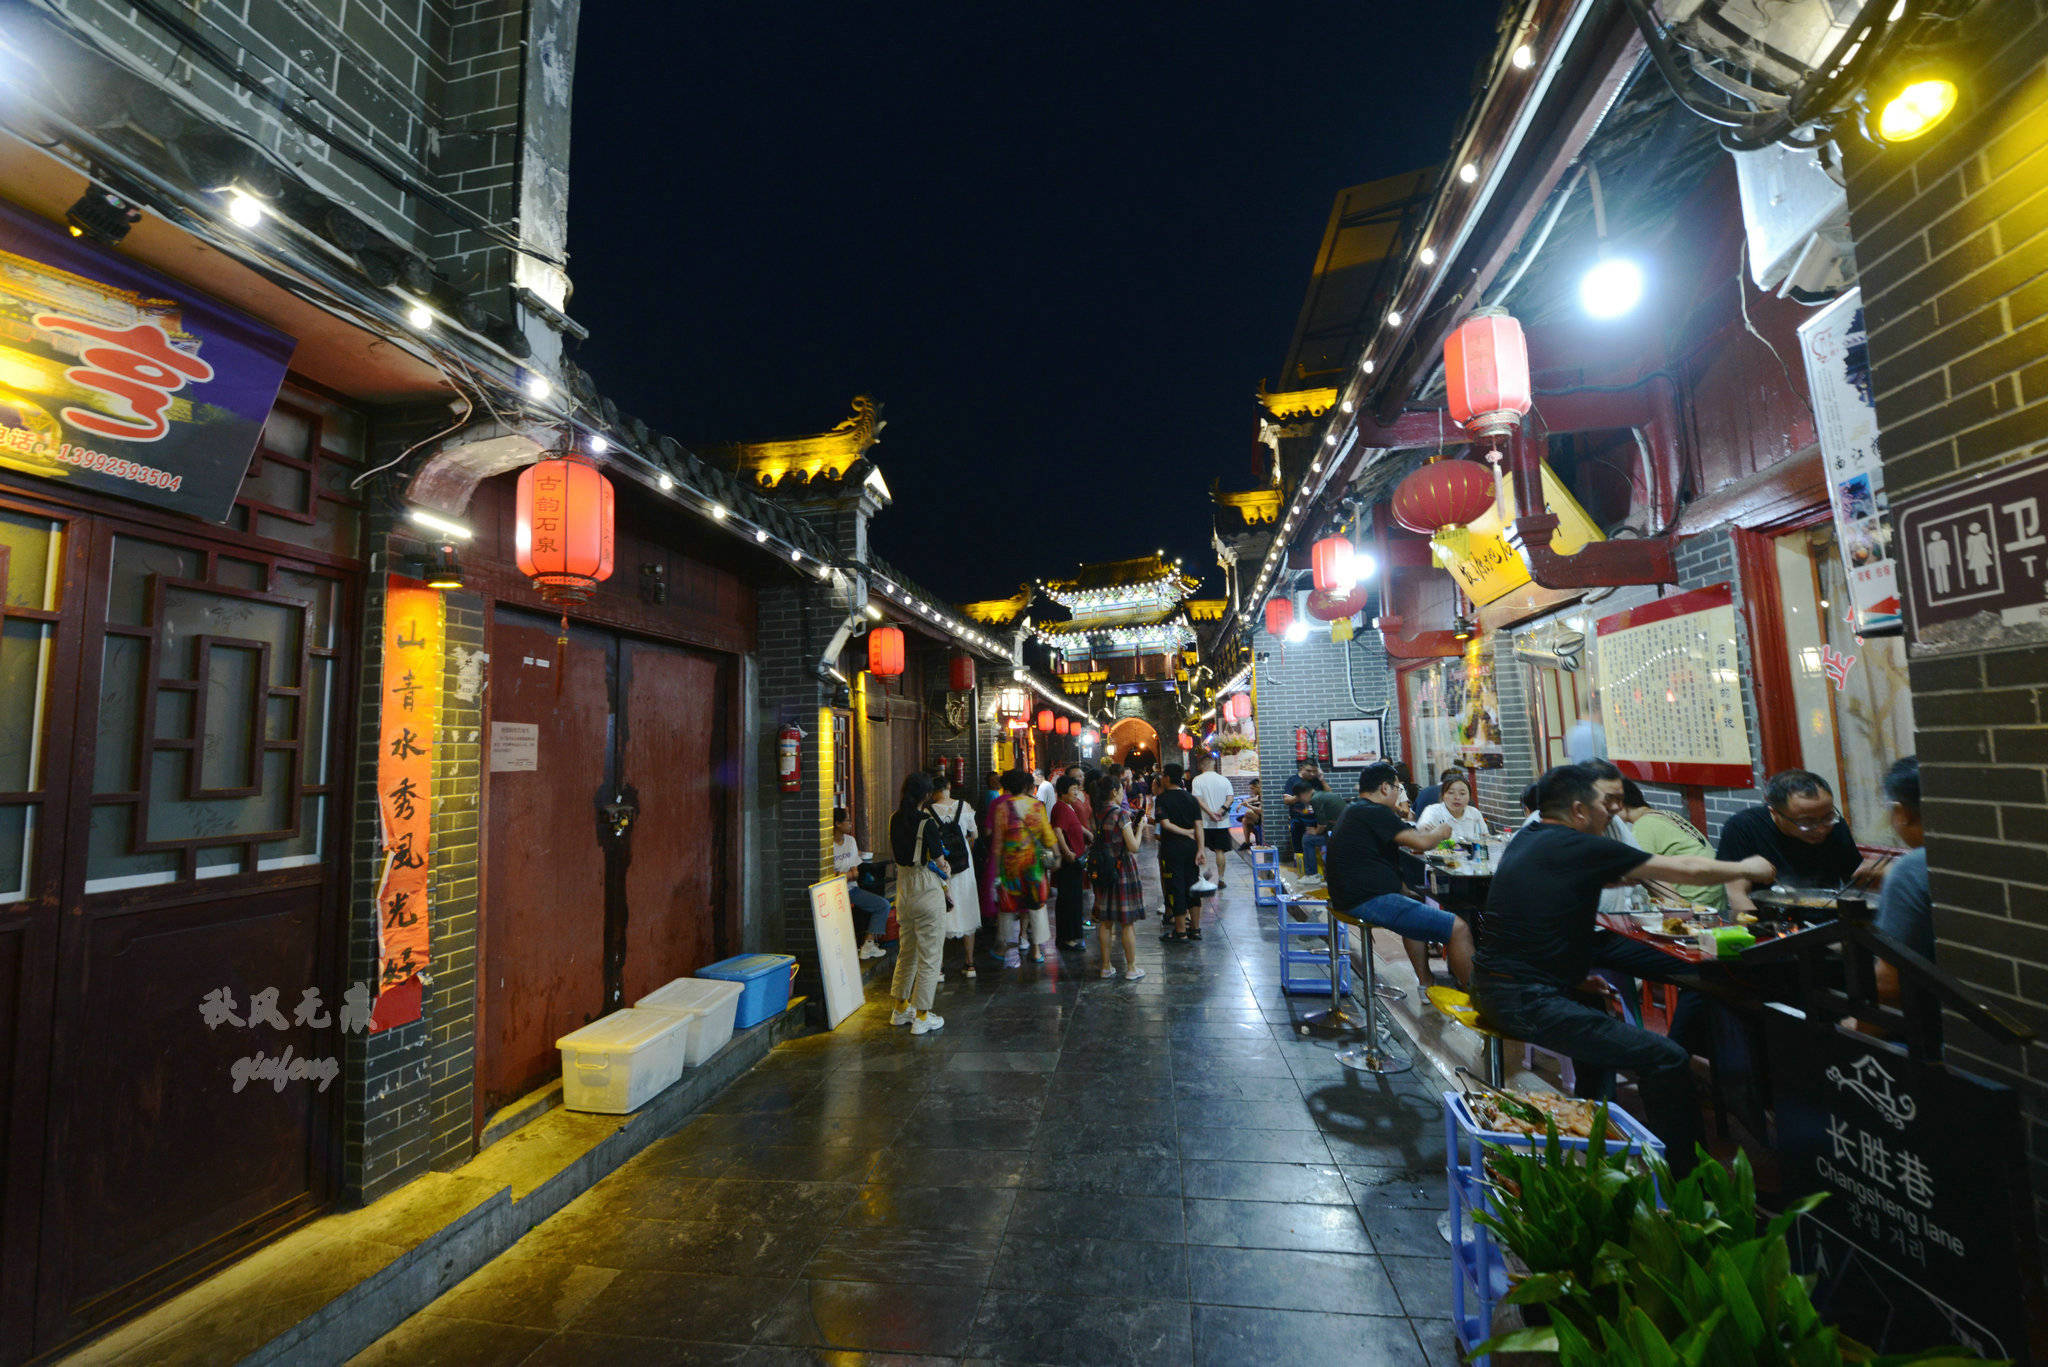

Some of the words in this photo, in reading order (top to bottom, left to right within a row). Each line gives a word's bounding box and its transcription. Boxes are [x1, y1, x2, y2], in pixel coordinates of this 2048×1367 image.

[57, 444, 182, 493] 13992593504
[535, 475, 562, 553] 古韵石泉
[2002, 497, 2047, 553] 卫
[384, 619, 426, 986] 山青水秀风光好
[1825, 1113, 1935, 1209] 长胜巷
[1816, 1156, 1919, 1235] Changsheng
[1923, 1214, 1965, 1257] lane
